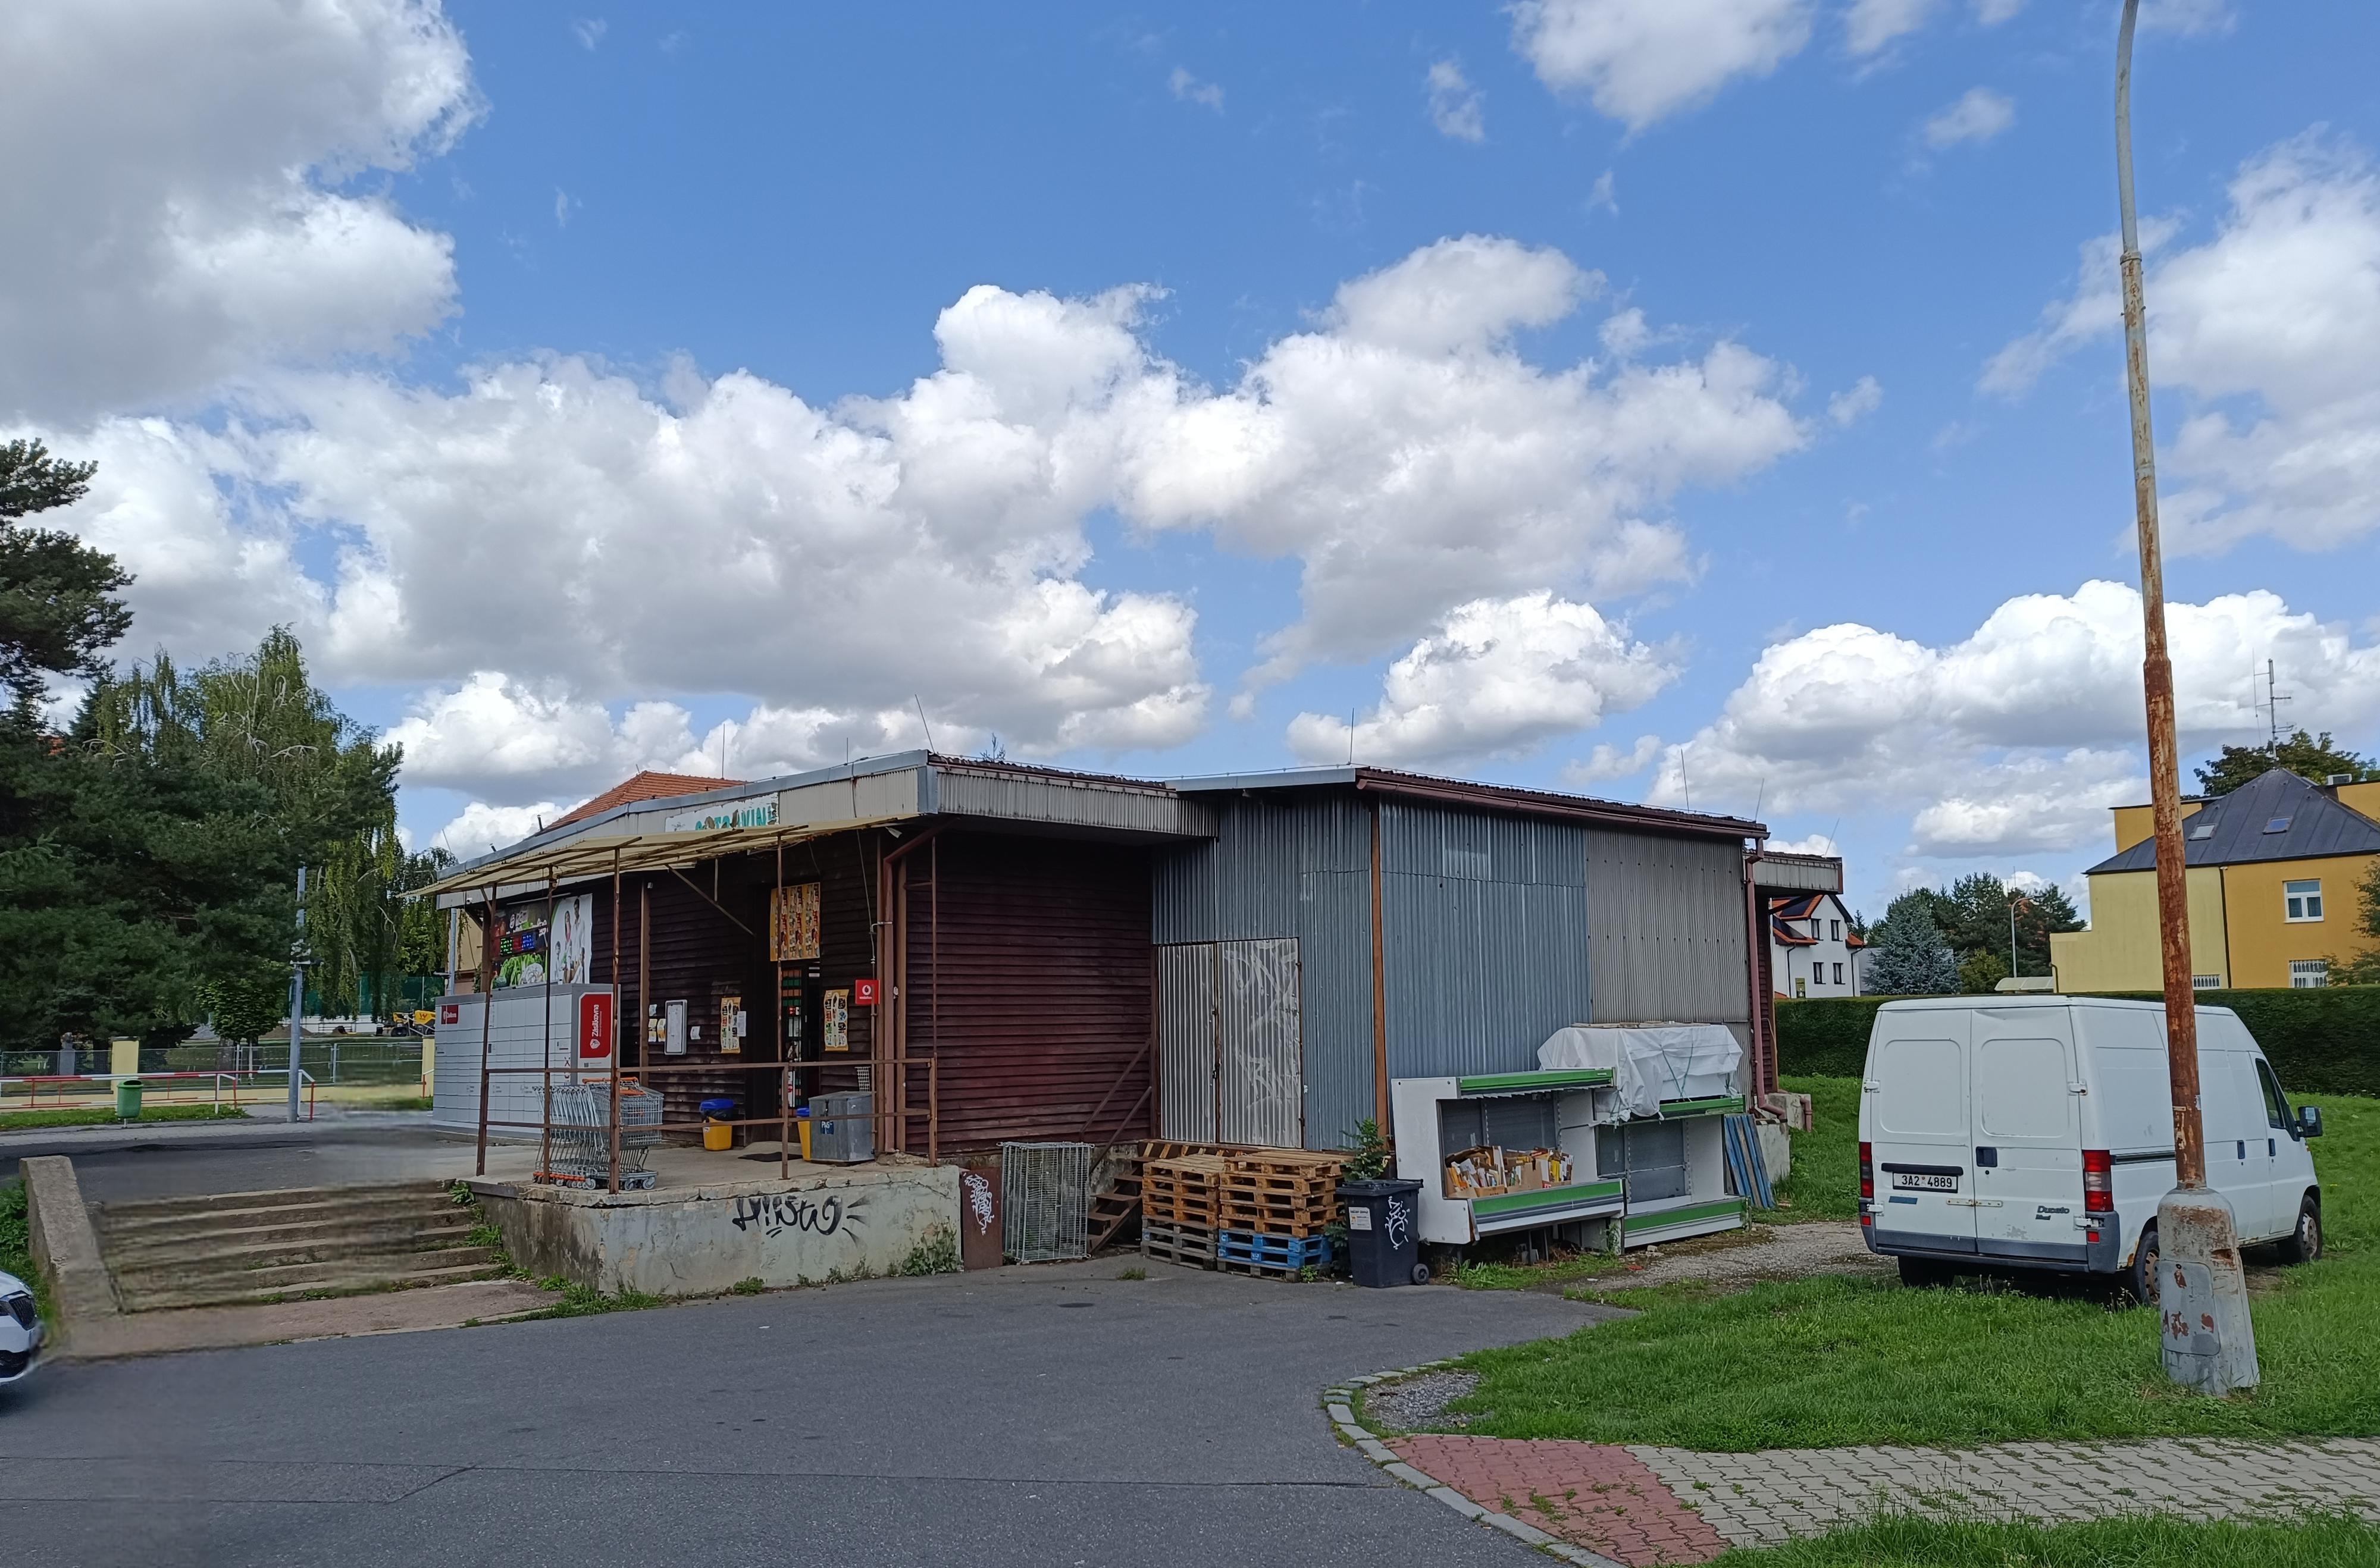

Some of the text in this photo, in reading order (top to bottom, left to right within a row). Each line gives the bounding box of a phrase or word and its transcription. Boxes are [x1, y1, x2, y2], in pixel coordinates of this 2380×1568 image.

[1902, 1175, 1952, 1188] 3A2 4889
[2037, 1205, 2070, 1214] Ducato
